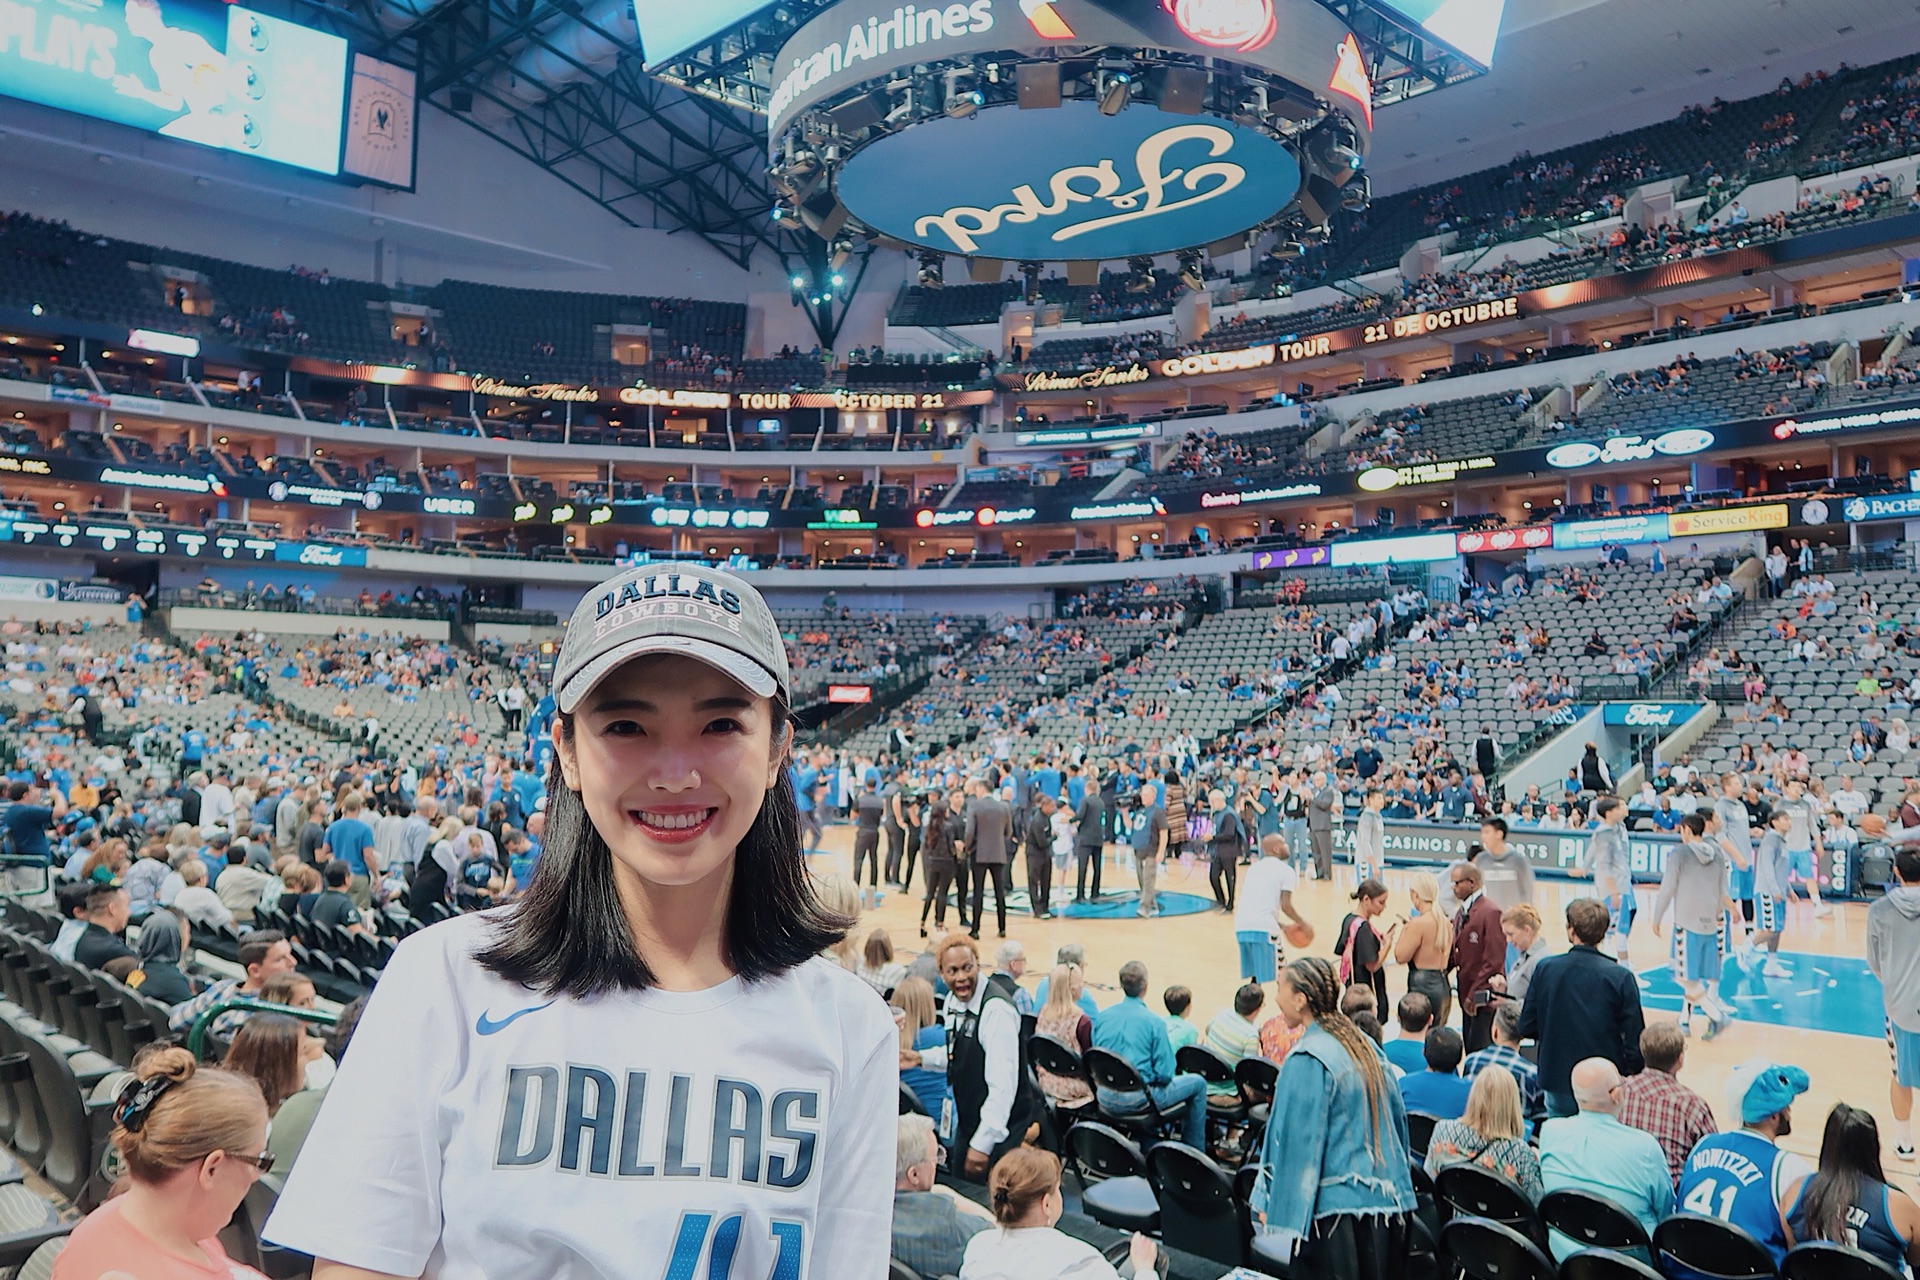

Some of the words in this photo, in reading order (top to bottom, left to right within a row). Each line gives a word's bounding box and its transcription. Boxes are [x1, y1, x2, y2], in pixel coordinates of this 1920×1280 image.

[843, 0, 995, 67] Airlines
[914, 124, 1246, 252] Ford
[1279, 336, 1331, 362] TOUR
[1364, 325, 1388, 343] 21
[1394, 315, 1421, 337] DE
[1425, 297, 1518, 331] OCTUBRE
[739, 393, 792, 410] TOUR
[835, 393, 916, 409] OCTOBER
[922, 393, 945, 409] 21
[1600, 436, 1655, 463] Ford
[424, 497, 475, 514] UBER
[299, 544, 342, 566] Ford
[595, 574, 741, 622] DALLAS
[594, 602, 740, 637] COWBOYS
[1625, 704, 1674, 726] Ford
[1382, 835, 1451, 851] CASINOS
[1456, 839, 1467, 854] &
[492, 1061, 822, 1192] DALLAS
[1693, 1148, 1764, 1187] NOWITZKI
[1683, 1178, 1738, 1222] 41
